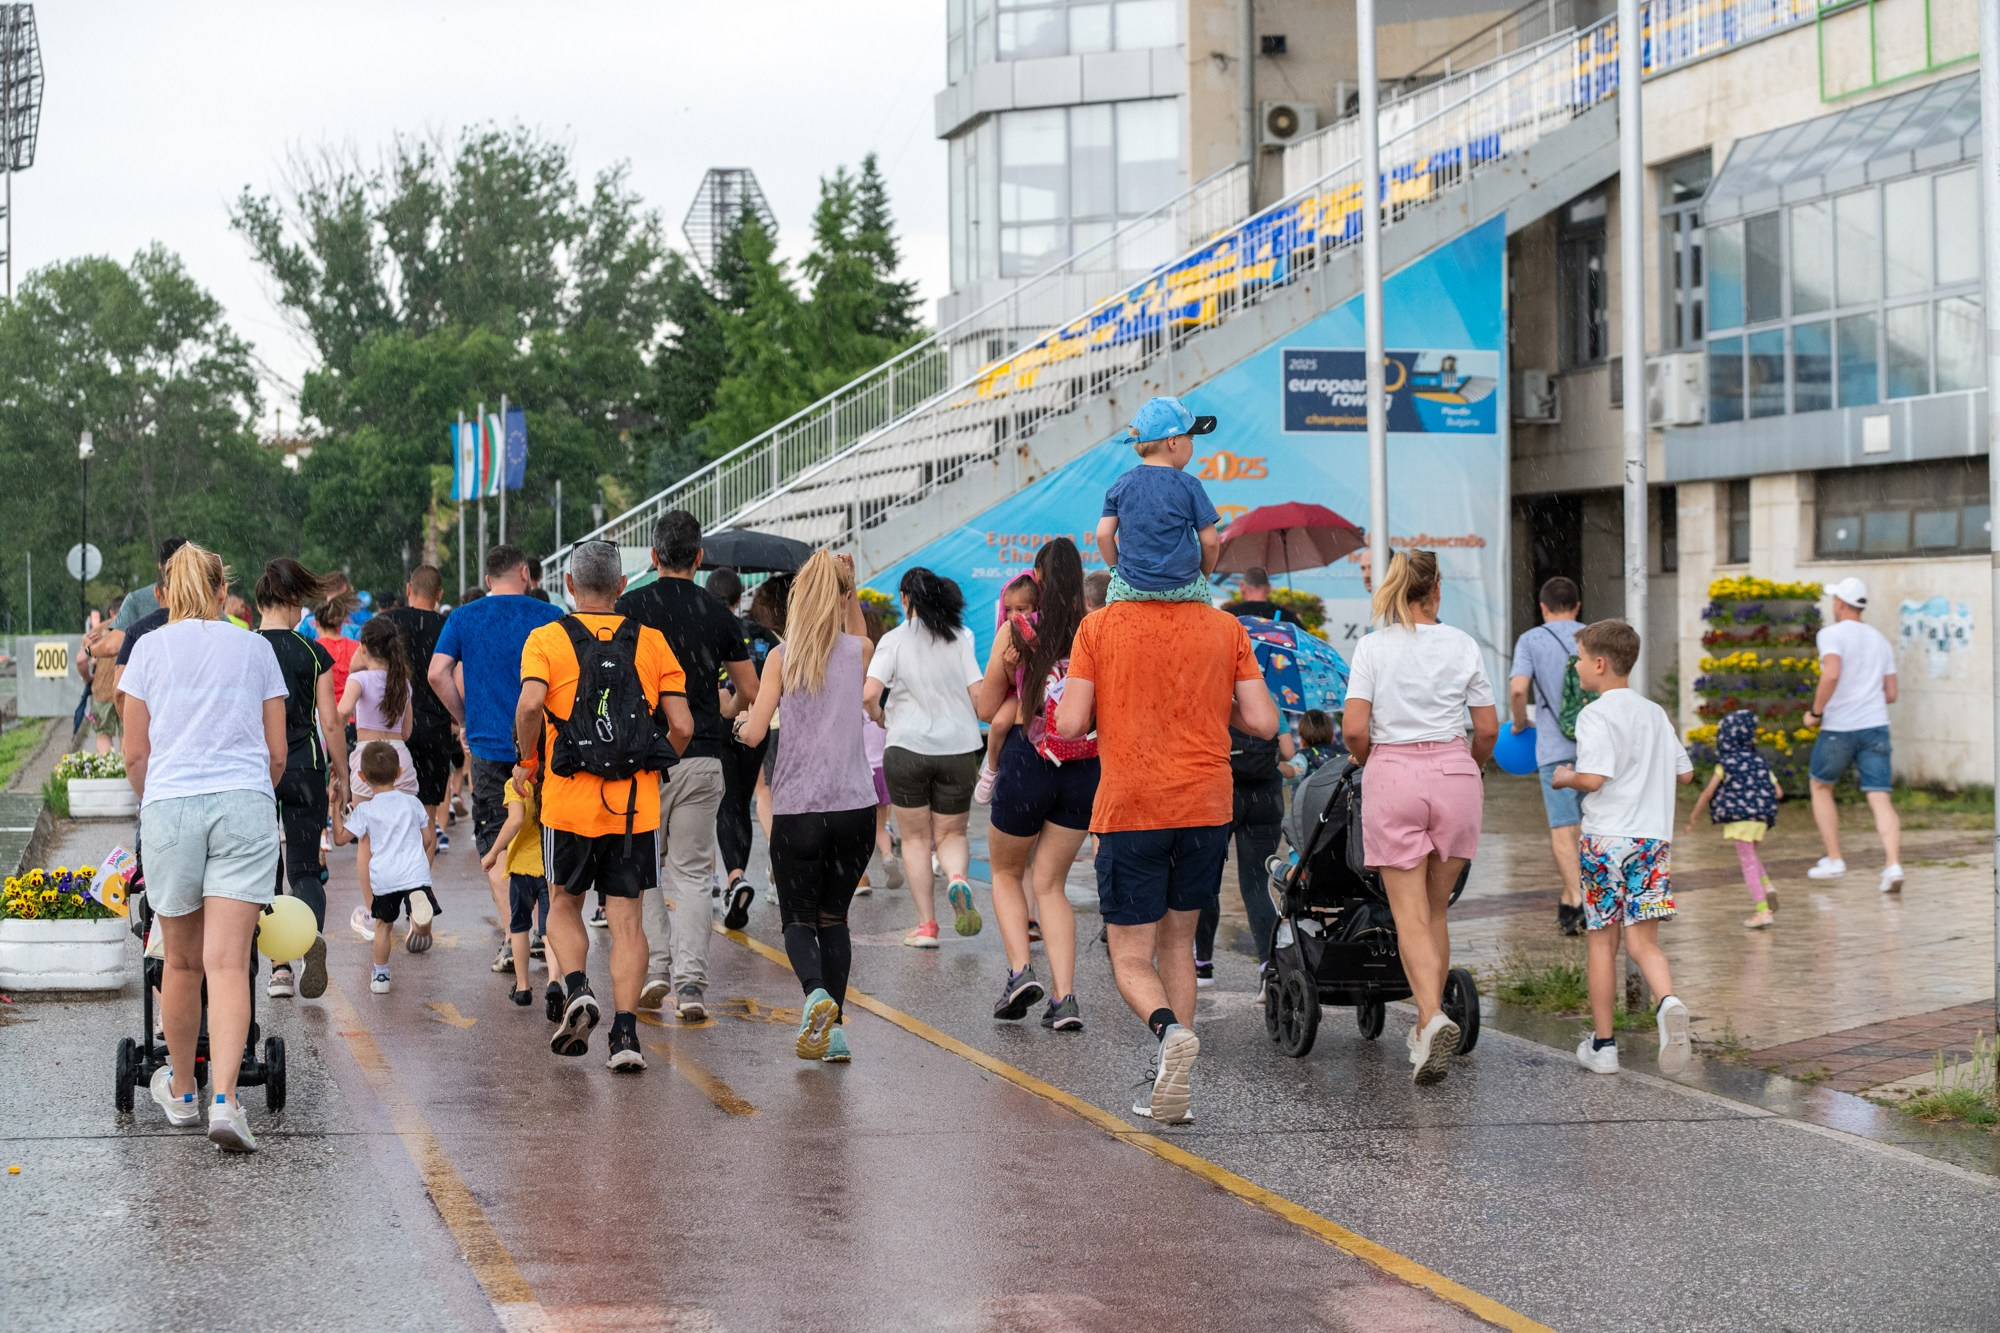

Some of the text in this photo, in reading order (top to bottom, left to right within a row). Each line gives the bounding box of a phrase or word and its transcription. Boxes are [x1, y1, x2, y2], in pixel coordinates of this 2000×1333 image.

[1288, 358, 1318, 371] 2025
[1197, 450, 1268, 481] 2025
[36, 649, 68, 670] 2000
